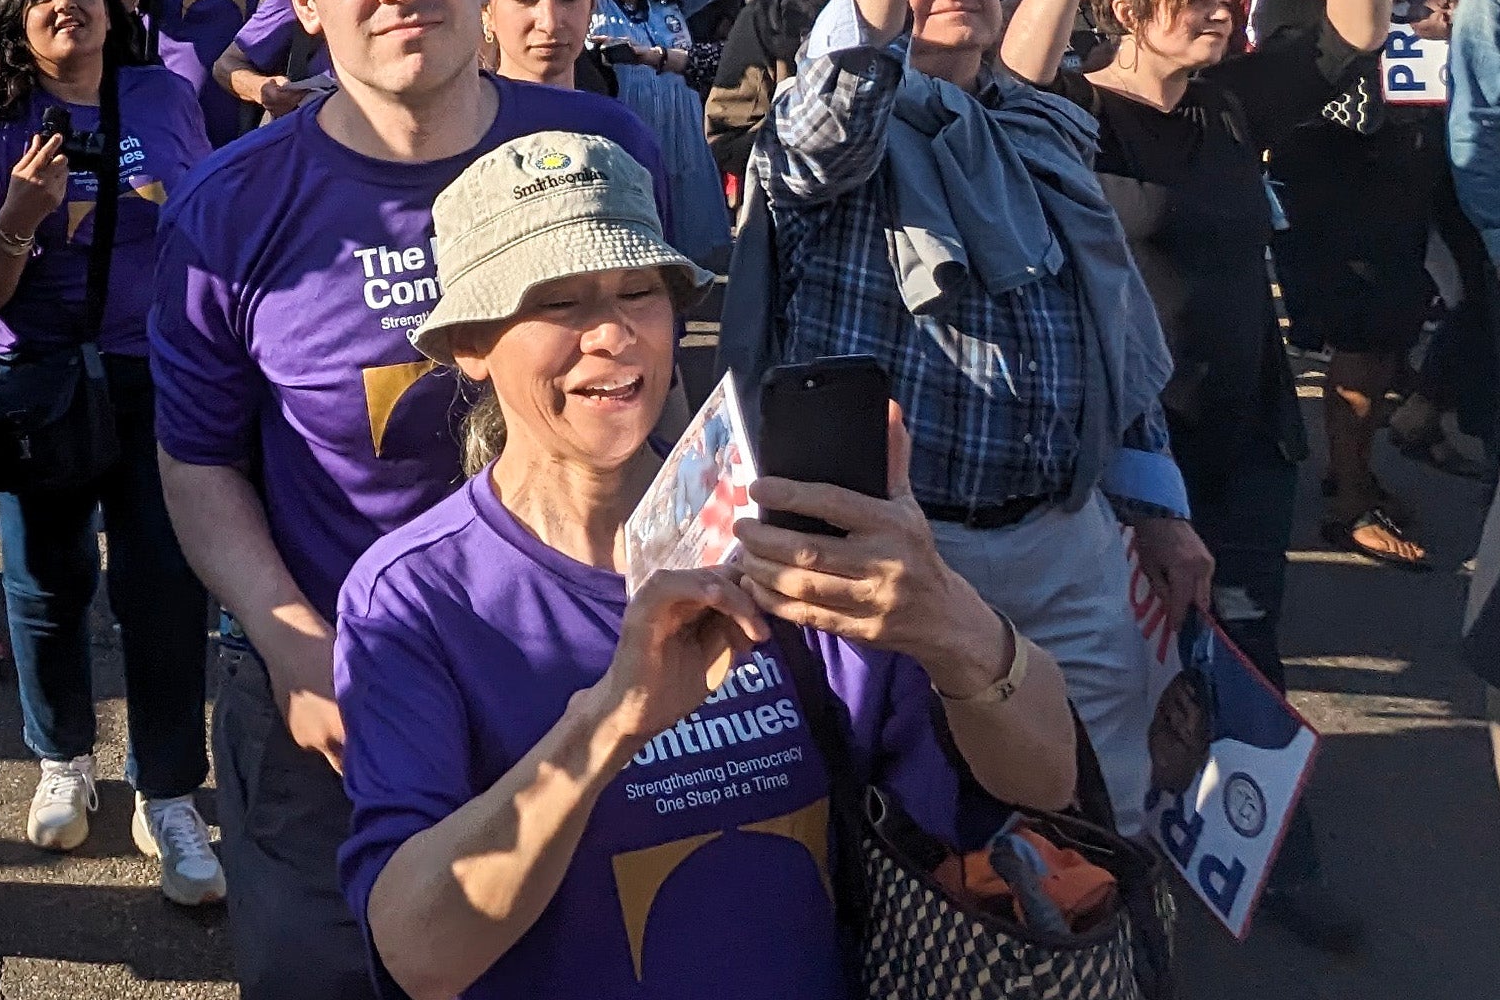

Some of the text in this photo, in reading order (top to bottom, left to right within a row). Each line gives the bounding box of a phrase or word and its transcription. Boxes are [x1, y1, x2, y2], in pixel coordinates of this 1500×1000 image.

[513, 165, 609, 199] Smithsonian
[353, 246, 426, 278] The
[621, 698, 799, 769] ontinues
[626, 746, 803, 799] Strengthening Democracy
[656, 773, 789, 814] One Step at a Time
